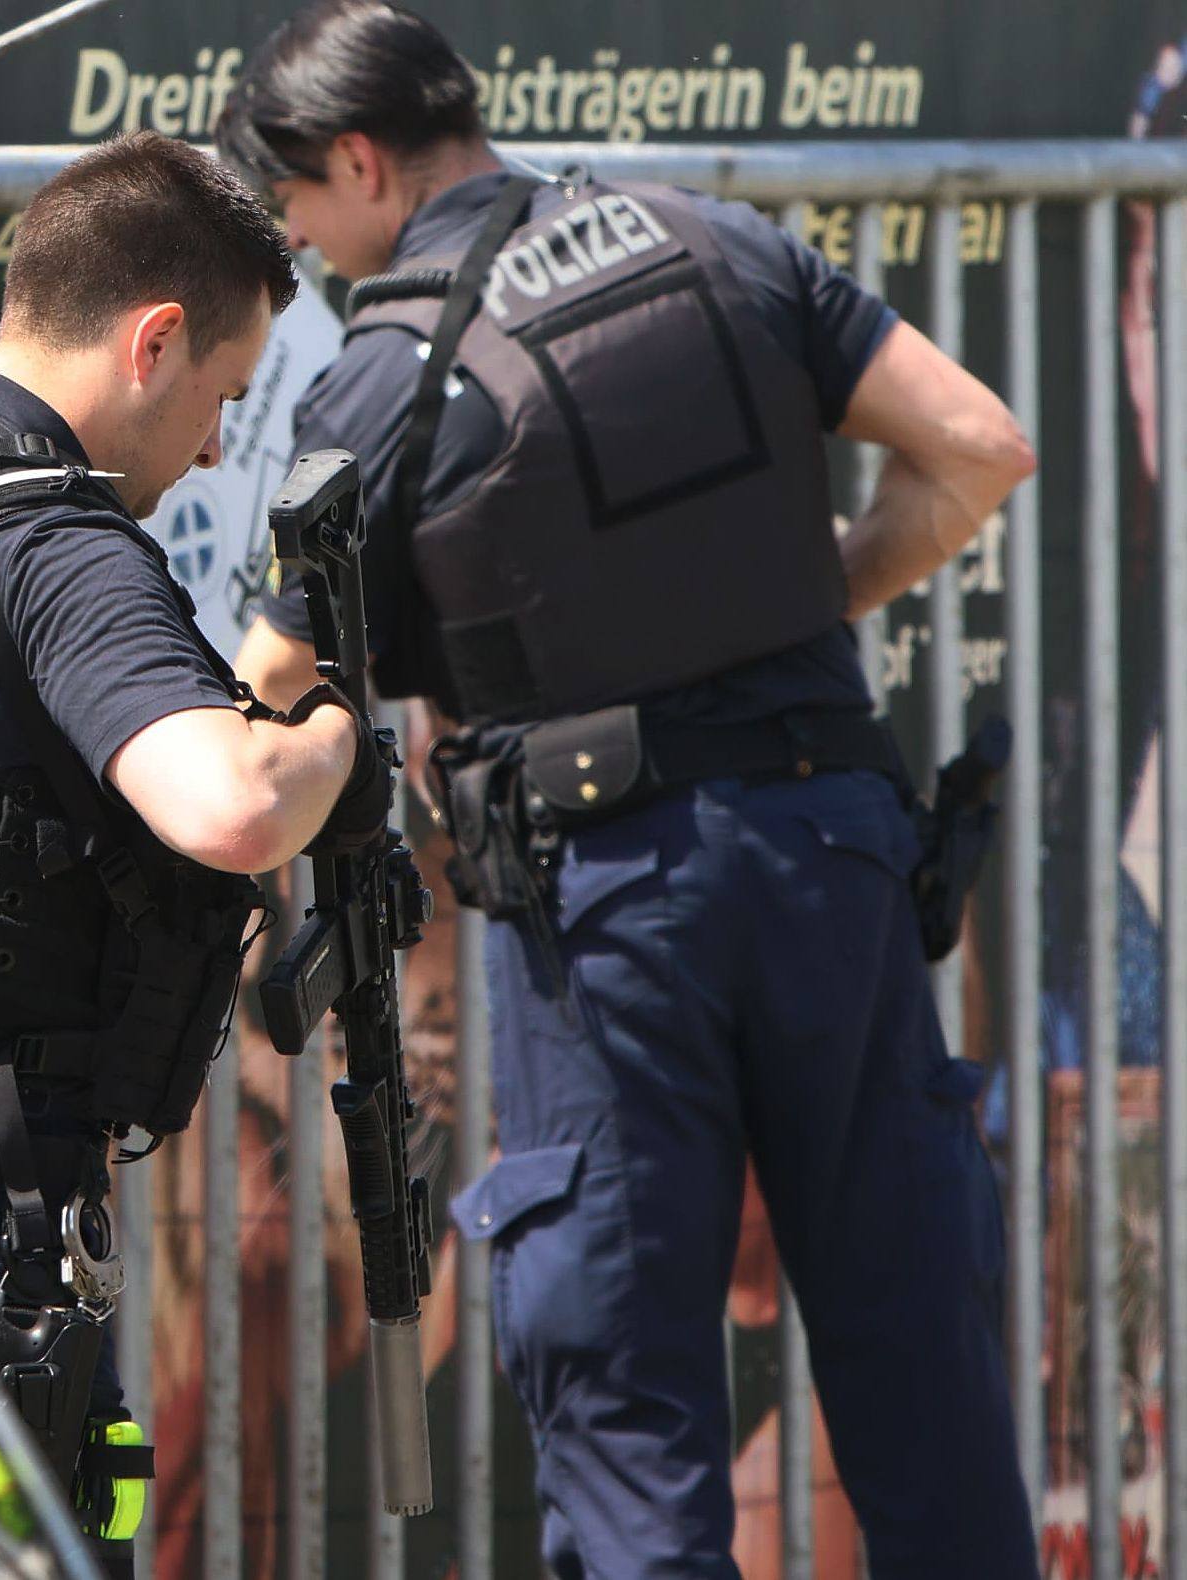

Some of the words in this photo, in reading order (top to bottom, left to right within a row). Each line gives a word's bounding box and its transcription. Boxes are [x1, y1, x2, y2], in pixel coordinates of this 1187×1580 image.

[69, 47, 244, 137] Dreif
[475, 43, 765, 142] eisträgerin
[779, 39, 923, 128] beim
